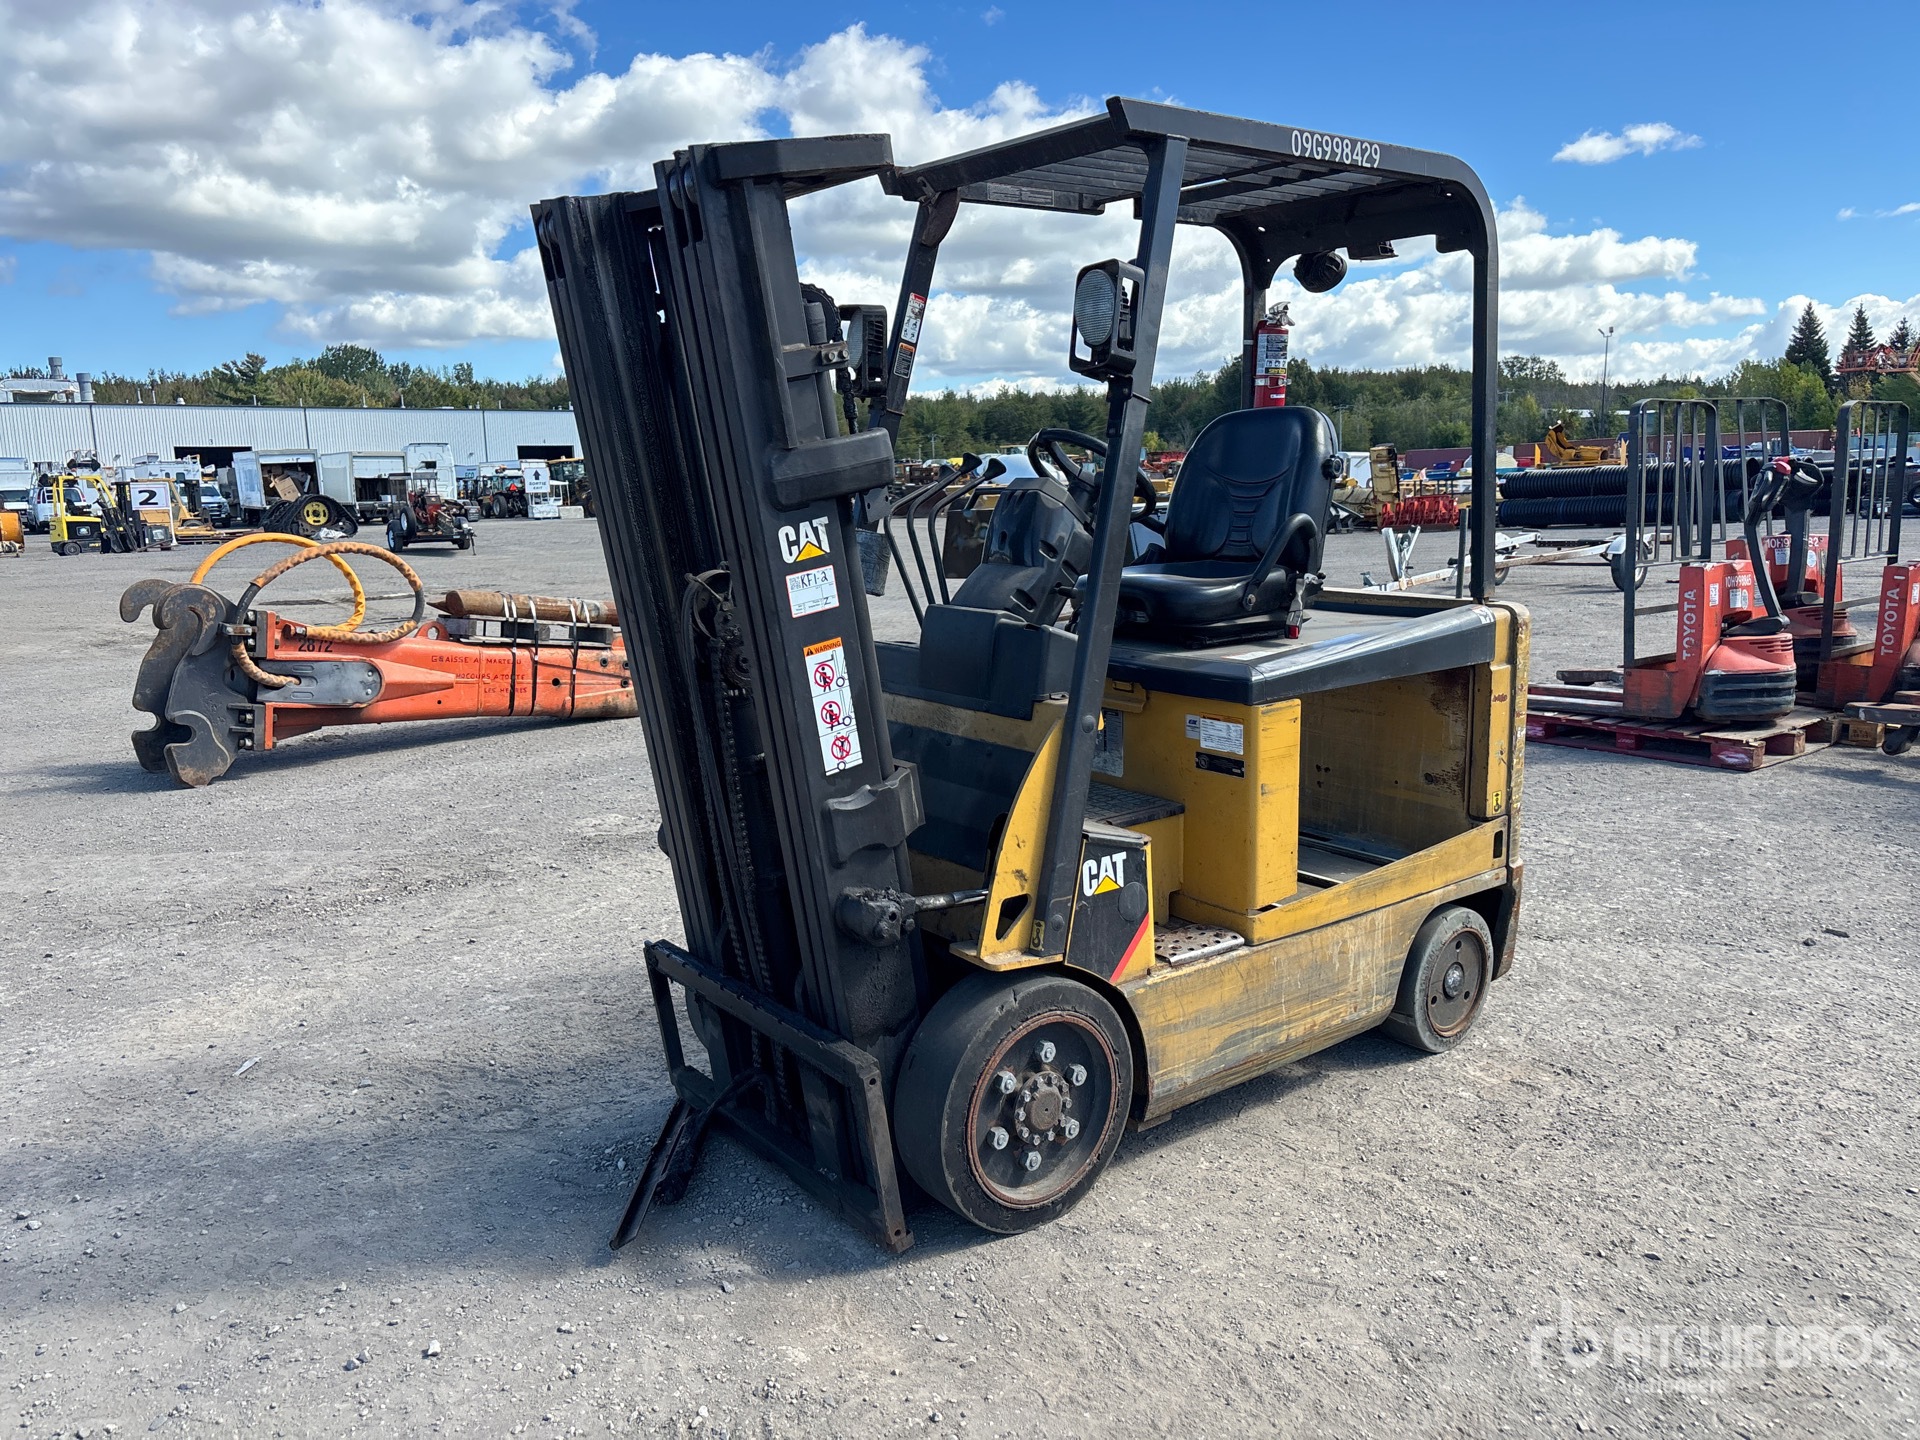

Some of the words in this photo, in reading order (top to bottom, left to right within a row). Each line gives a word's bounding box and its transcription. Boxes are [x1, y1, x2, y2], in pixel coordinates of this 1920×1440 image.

[1291, 129, 1380, 169] 09G998429
[137, 489, 159, 506] 2
[777, 515, 830, 564] CAT
[1682, 588, 1697, 661] TOYOTA
[1880, 587, 1900, 656] TOYOTA
[298, 639, 333, 653] 2872
[814, 640, 841, 654] WARNING
[1081, 850, 1127, 898] CAT
